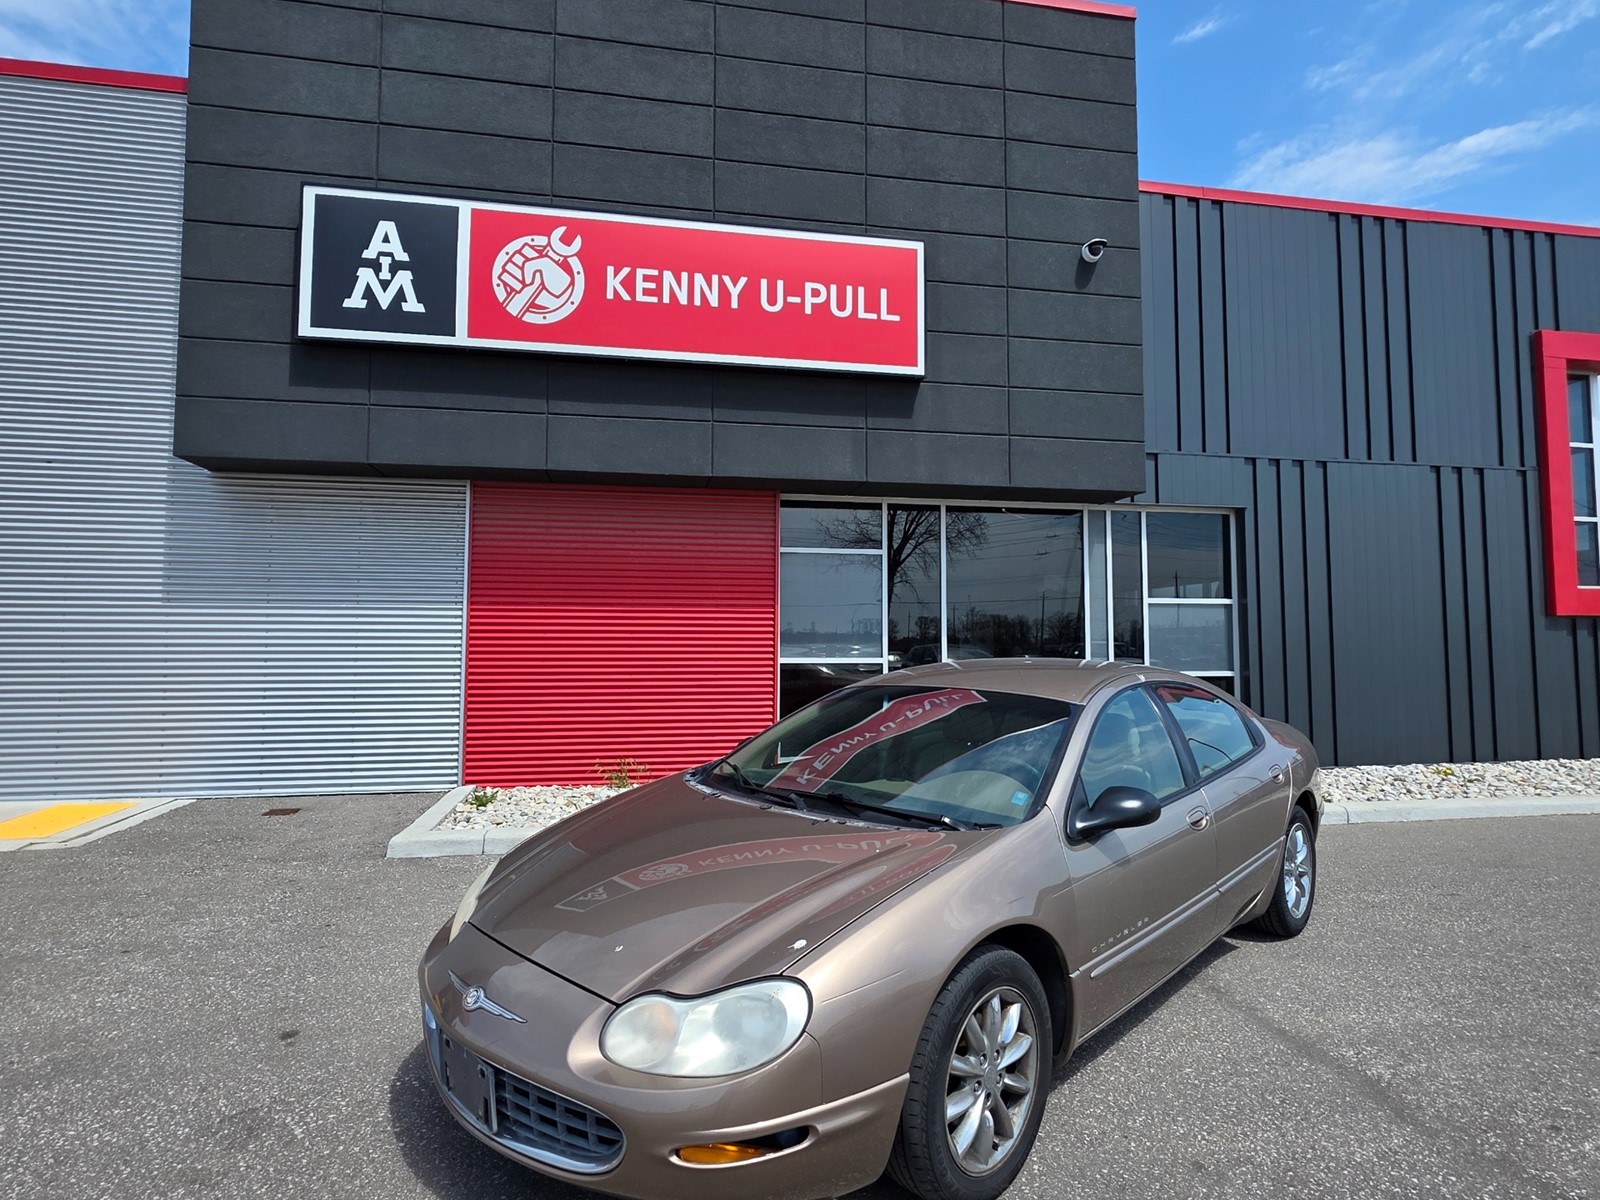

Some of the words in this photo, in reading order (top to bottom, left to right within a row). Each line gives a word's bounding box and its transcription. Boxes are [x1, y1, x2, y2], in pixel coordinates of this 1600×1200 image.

[342, 220, 426, 313] AIM
[606, 265, 748, 309] KENNY
[760, 277, 901, 322] U-PULL
